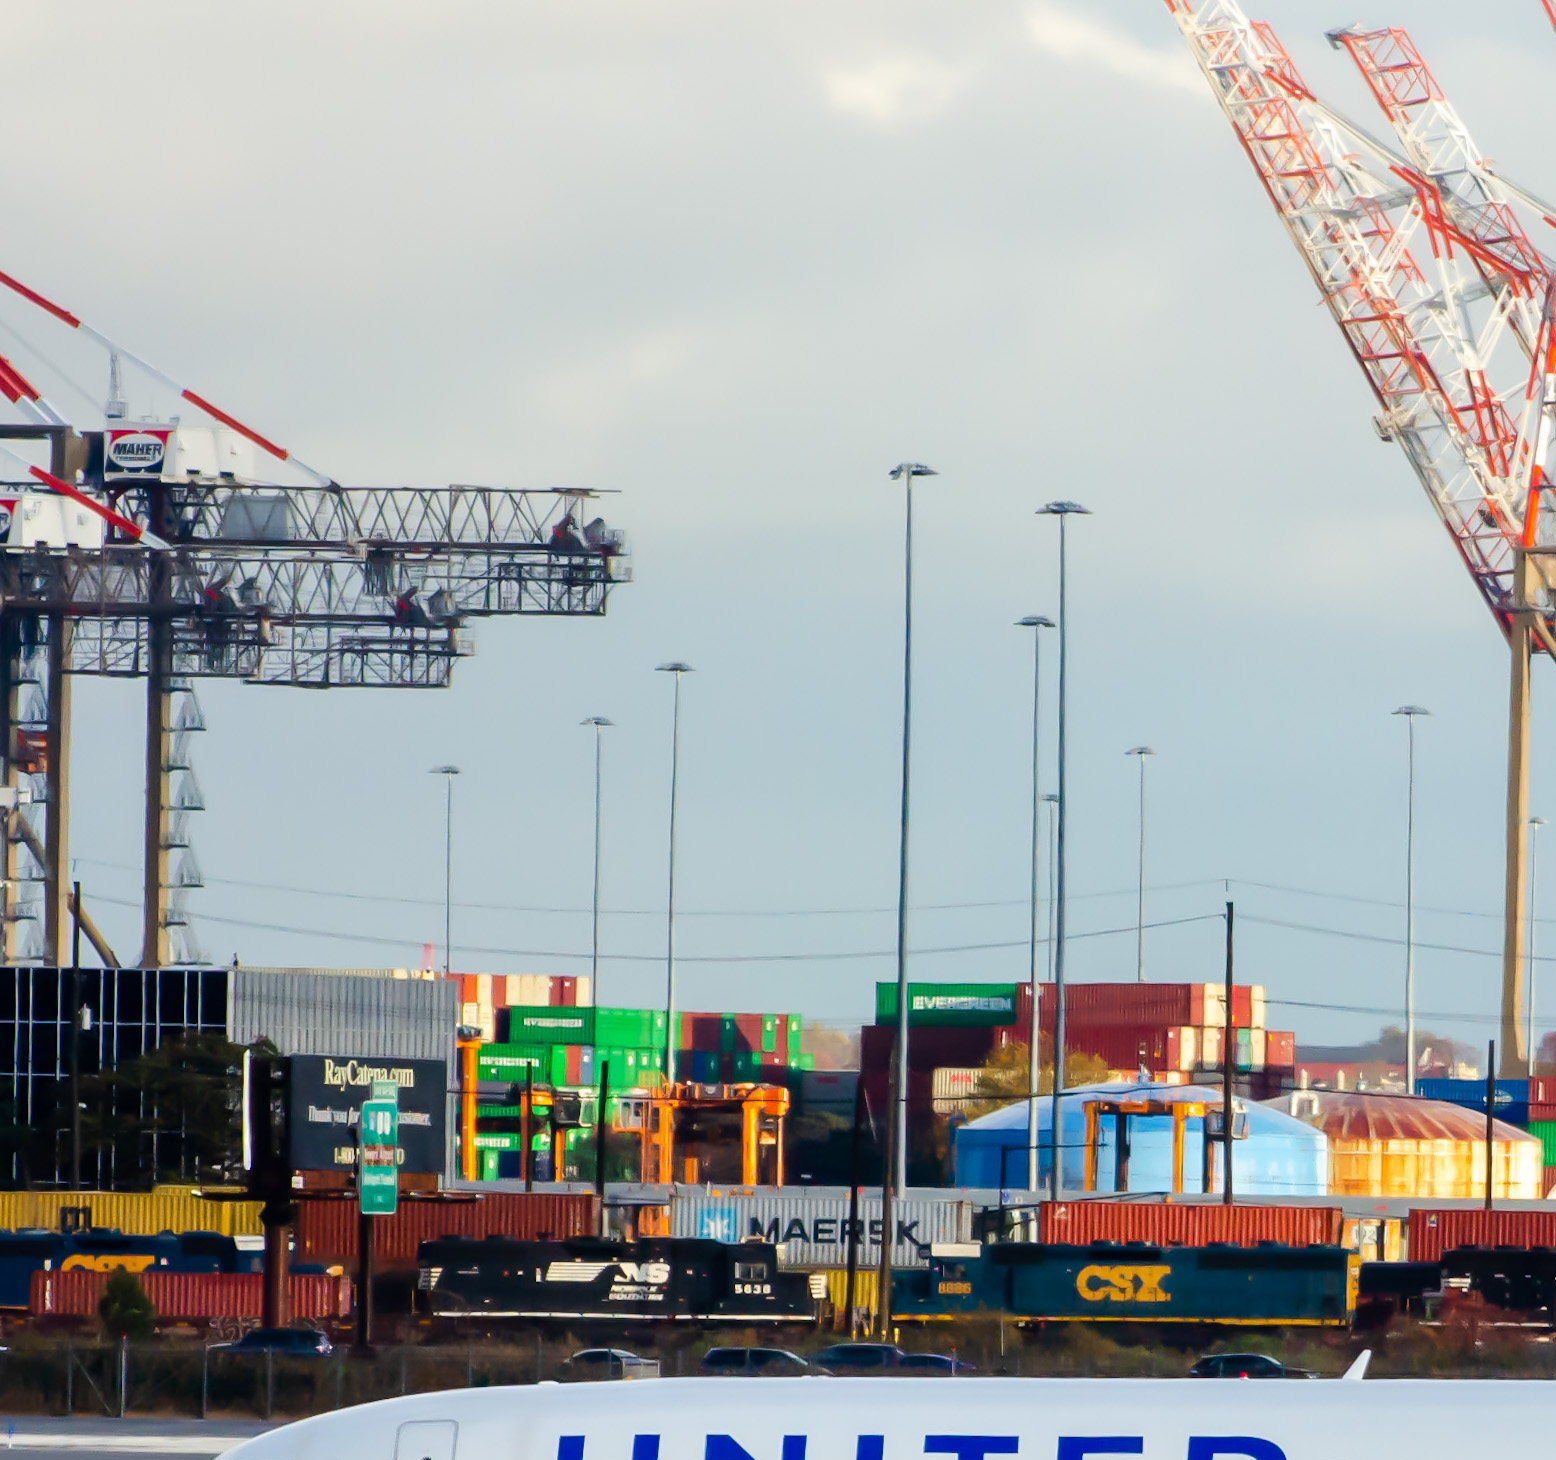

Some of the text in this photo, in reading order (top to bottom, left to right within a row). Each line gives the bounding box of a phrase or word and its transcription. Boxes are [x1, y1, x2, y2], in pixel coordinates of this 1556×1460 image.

[113, 443, 163, 456] MAHER
[913, 996, 1012, 1010] EVERGREEN
[323, 1059, 414, 1091] RayCatenacom
[750, 1217, 920, 1247] MAERSK
[1077, 1265, 1171, 1302] CSX
